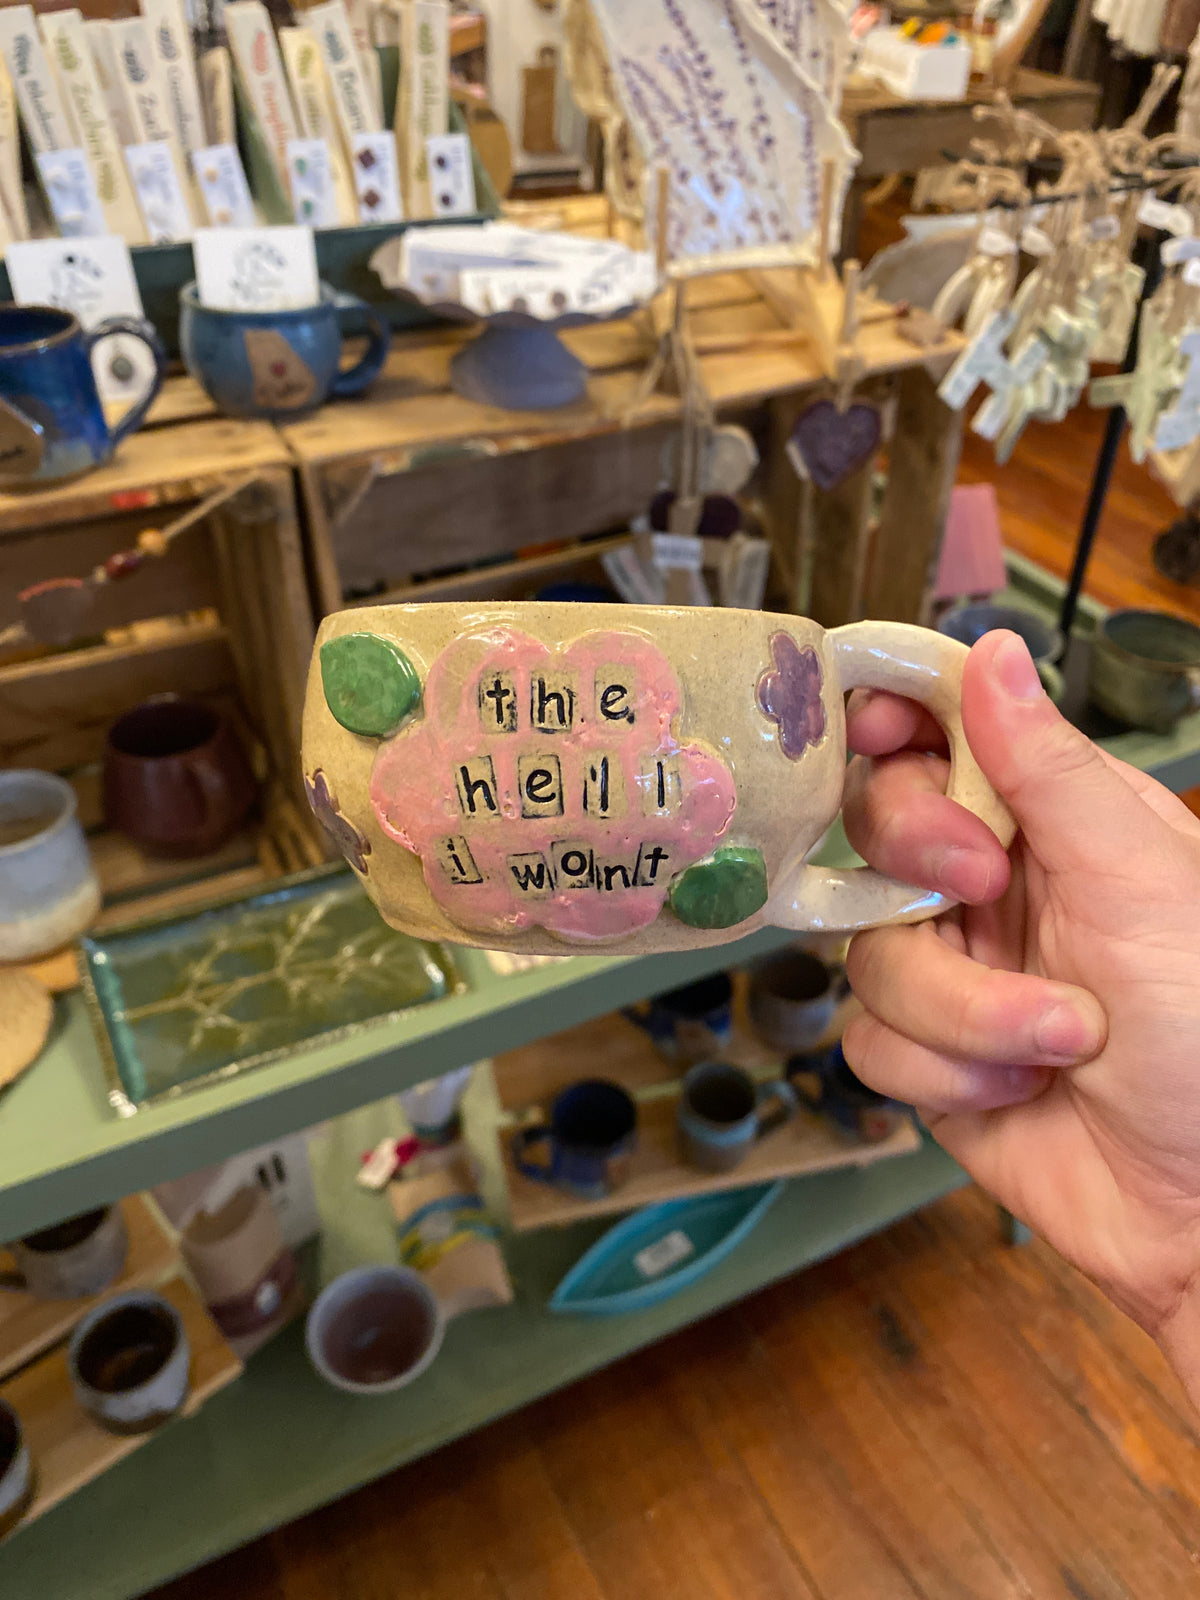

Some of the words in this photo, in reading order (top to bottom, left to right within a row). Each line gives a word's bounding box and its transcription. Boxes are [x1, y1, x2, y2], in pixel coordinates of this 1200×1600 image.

[485, 678, 630, 726] the
[459, 756, 665, 813] hell
[446, 838, 467, 877] i
[510, 846, 670, 892] wont
